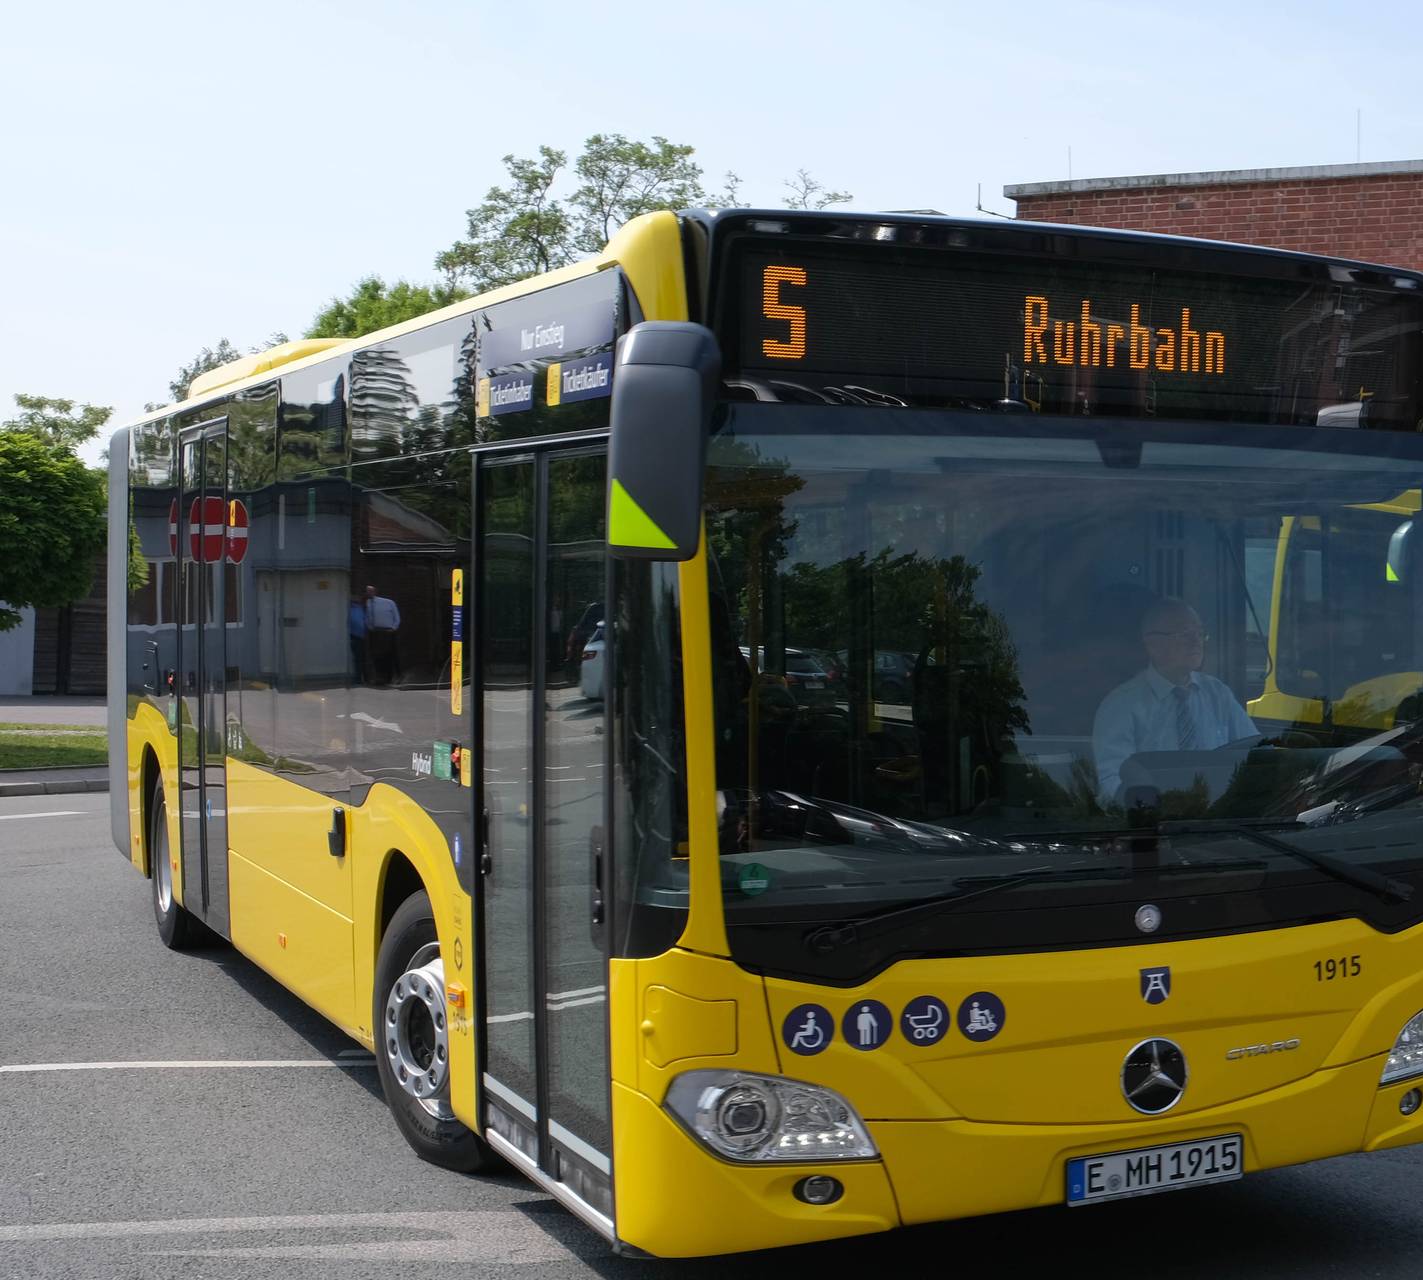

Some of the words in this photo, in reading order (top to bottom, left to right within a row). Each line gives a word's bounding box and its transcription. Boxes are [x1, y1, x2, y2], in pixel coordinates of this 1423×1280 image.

[521, 329, 534, 351] Nur
[535, 321, 564, 348] Einstieg
[1024, 296, 1225, 374] Ruhrbahn
[563, 363, 609, 393] Ticketkäufer
[490, 380, 532, 407] Ticketinhaber
[412, 752, 432, 776] Hybrid
[1313, 955, 1361, 982] 1915
[1225, 1038, 1301, 1061] CITARO
[1088, 1162, 1104, 1193] E
[1126, 1153, 1162, 1187] MH
[1169, 1142, 1237, 1180] 1915
